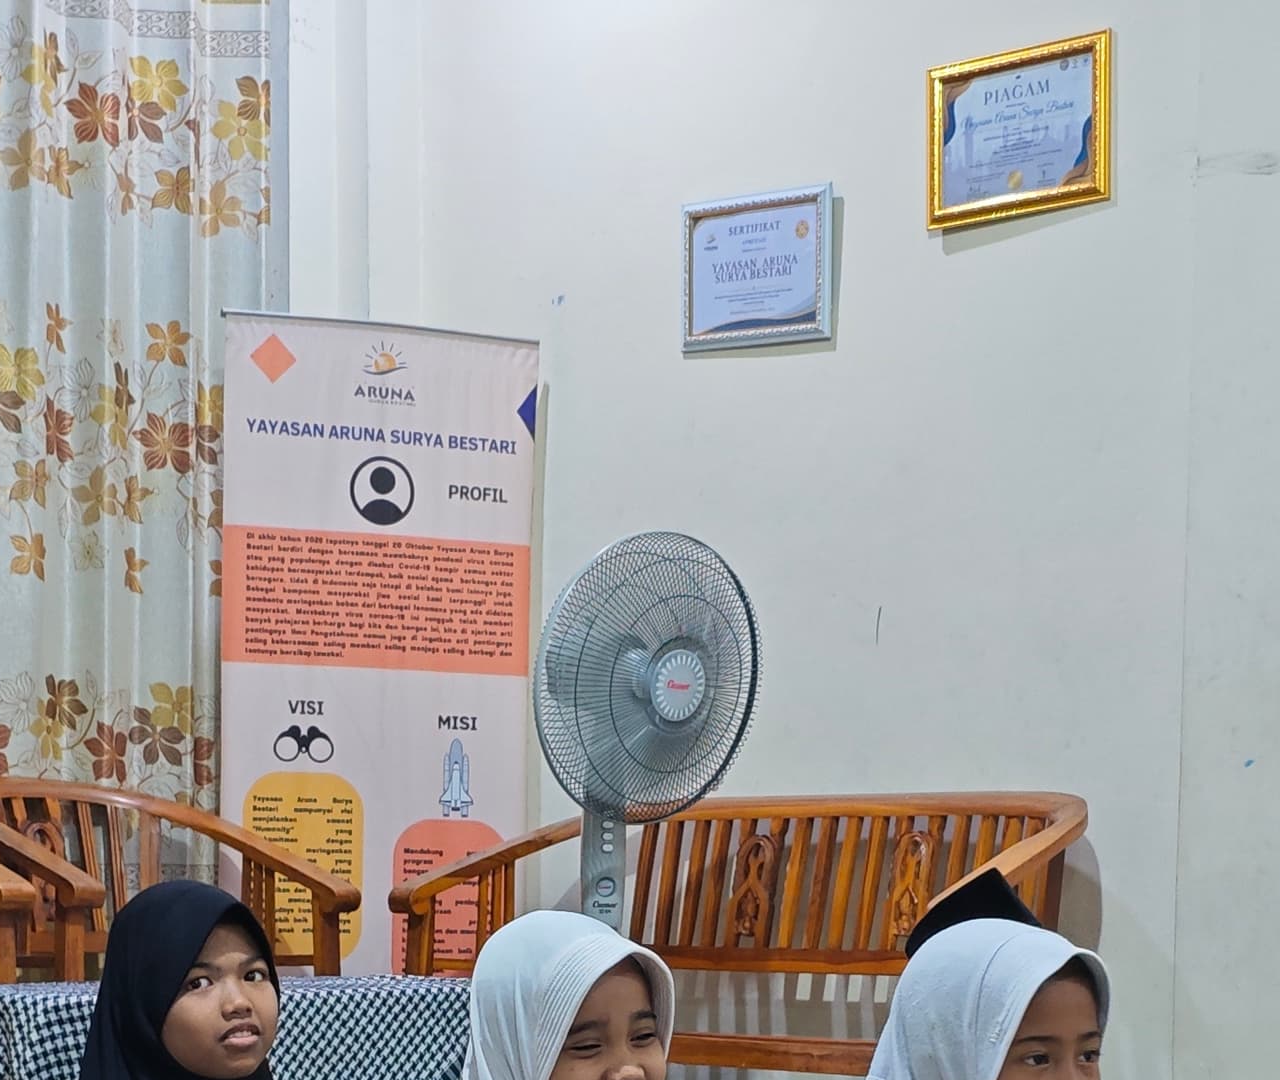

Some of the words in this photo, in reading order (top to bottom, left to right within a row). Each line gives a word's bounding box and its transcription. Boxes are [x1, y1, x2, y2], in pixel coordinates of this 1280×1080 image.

[984, 79, 1049, 106] PIAGAM
[728, 220, 781, 236] SERTIFIKAT
[712, 257, 757, 274] YAYASAN
[762, 253, 798, 268] ARUNA
[715, 270, 747, 284] SURYA
[749, 265, 792, 280] BESTARI
[354, 384, 415, 401] ARUNA
[246, 417, 324, 438] YAYASAN
[328, 424, 386, 443] ARUNA
[390, 430, 444, 449] SURYA
[448, 435, 517, 455] BESTARI
[448, 484, 508, 504] PROFIL
[288, 699, 324, 716] VISI
[437, 715, 477, 731] MISI
